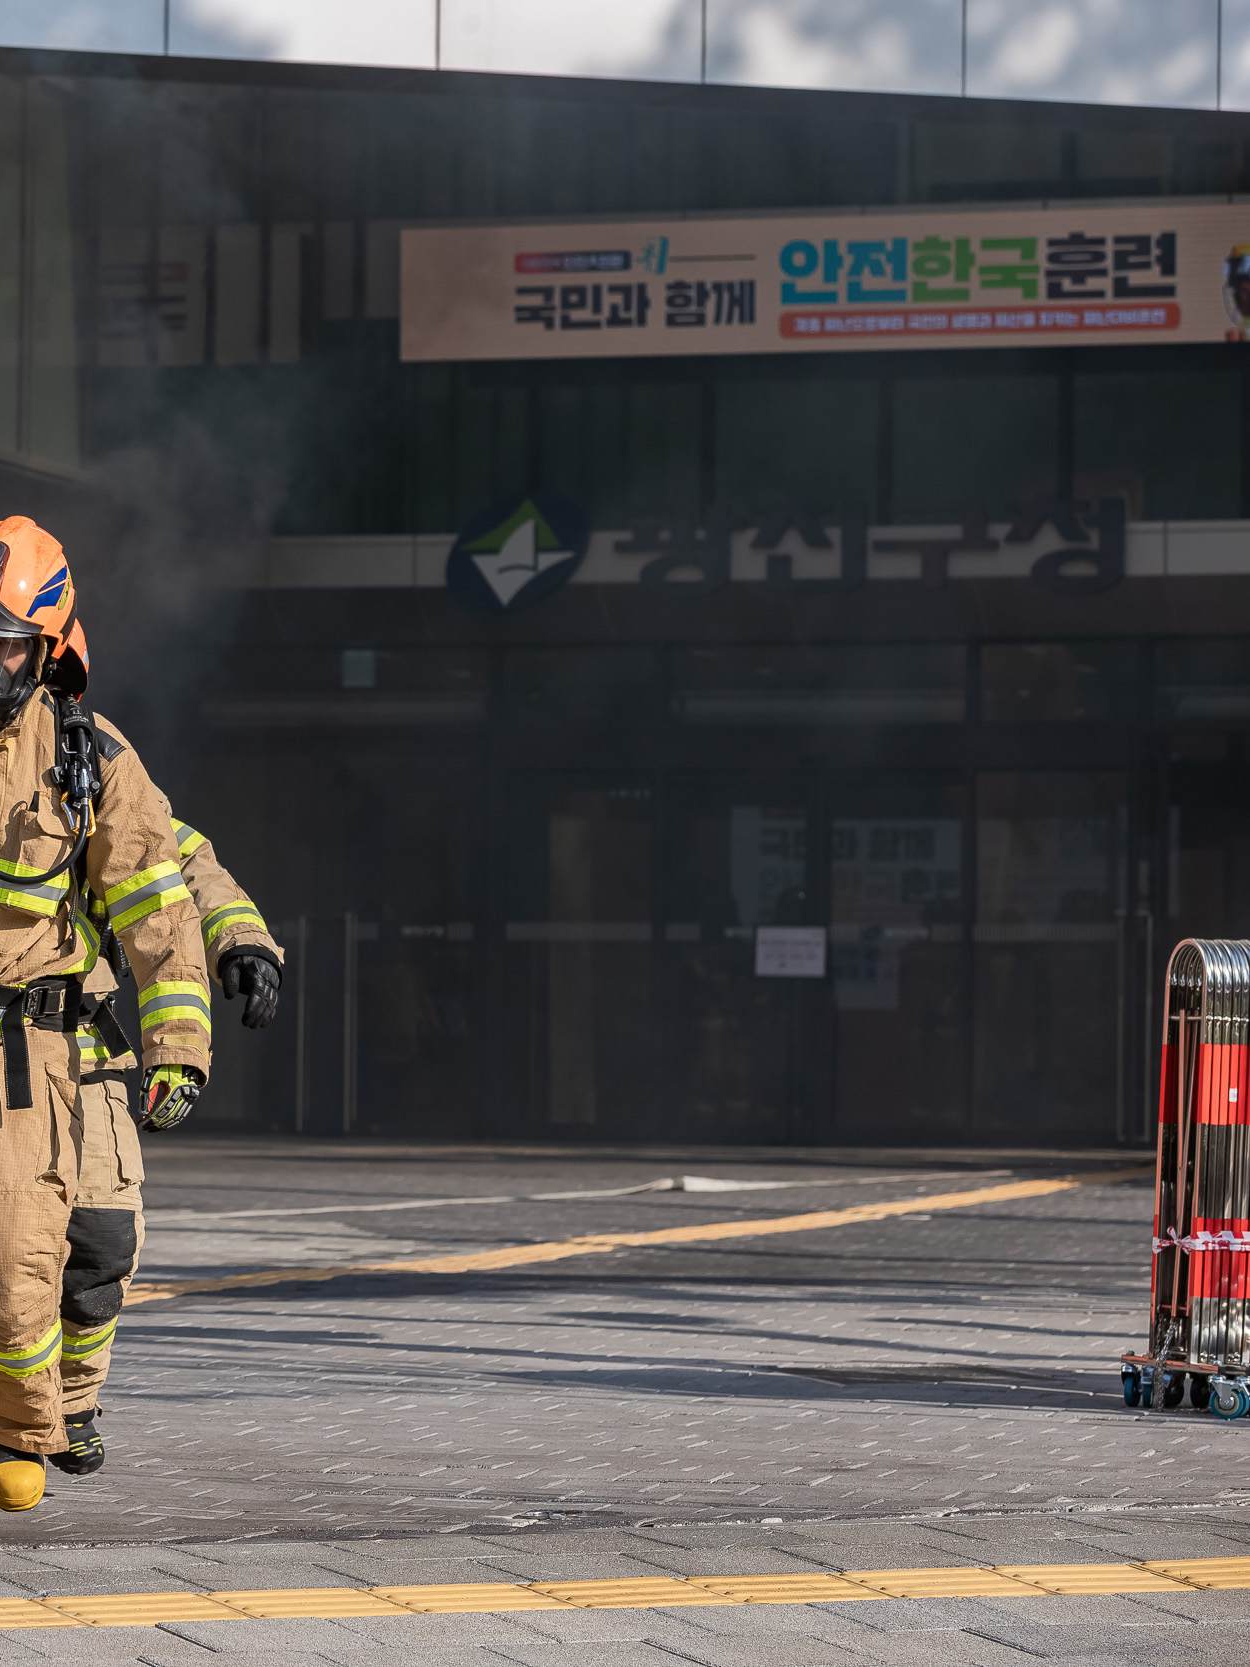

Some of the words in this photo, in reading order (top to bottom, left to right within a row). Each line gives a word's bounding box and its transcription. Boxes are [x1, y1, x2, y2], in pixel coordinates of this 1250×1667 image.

[780, 232, 1177, 303] 안전한국훈련
[514, 281, 651, 331] 국민과
[665, 278, 757, 328] 함께
[615, 495, 1126, 596] 광진구청
